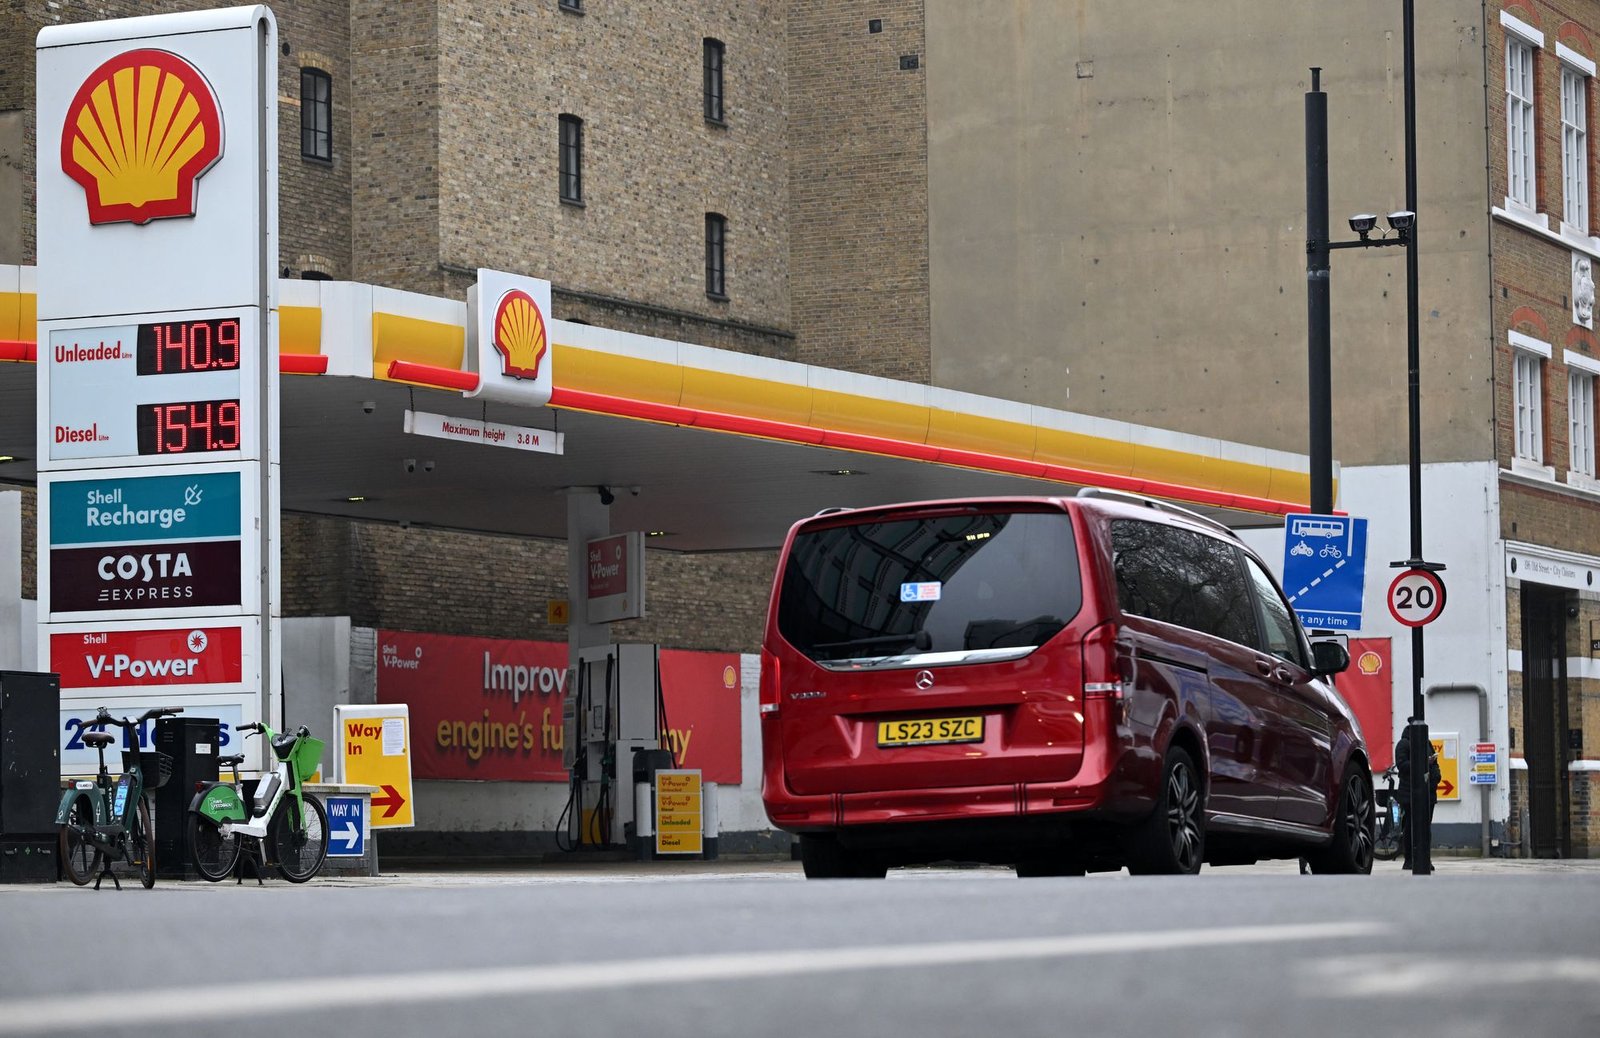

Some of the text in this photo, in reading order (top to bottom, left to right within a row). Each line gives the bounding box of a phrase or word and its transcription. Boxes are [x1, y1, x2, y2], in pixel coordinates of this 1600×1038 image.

[55, 340, 121, 363] Unleaded
[153, 320, 239, 372] 140.9
[55, 422, 97, 444] Diesel
[153, 402, 240, 453] 154.9
[442, 421, 540, 446] Maximum height 3.8 M
[87, 487, 122, 505] Shell
[86, 504, 187, 529] Recharge
[97, 552, 193, 582] COSTA
[590, 562, 620, 580] V-Power
[112, 586, 193, 601] EXPRESS
[1395, 585, 1434, 610] 20
[553, 605, 562, 619] 4
[1307, 617, 1324, 627] any
[1327, 616, 1349, 626] time
[83, 633, 107, 645] Shell
[382, 644, 397, 655] Shell
[85, 653, 199, 679] V-Power
[382, 654, 420, 669] V-Power
[484, 651, 568, 703] Improv
[347, 723, 383, 740] Way
[885, 719, 975, 742] LS23 SZC
[347, 742, 363, 756] In
[330, 804, 360, 817] WAY IN
